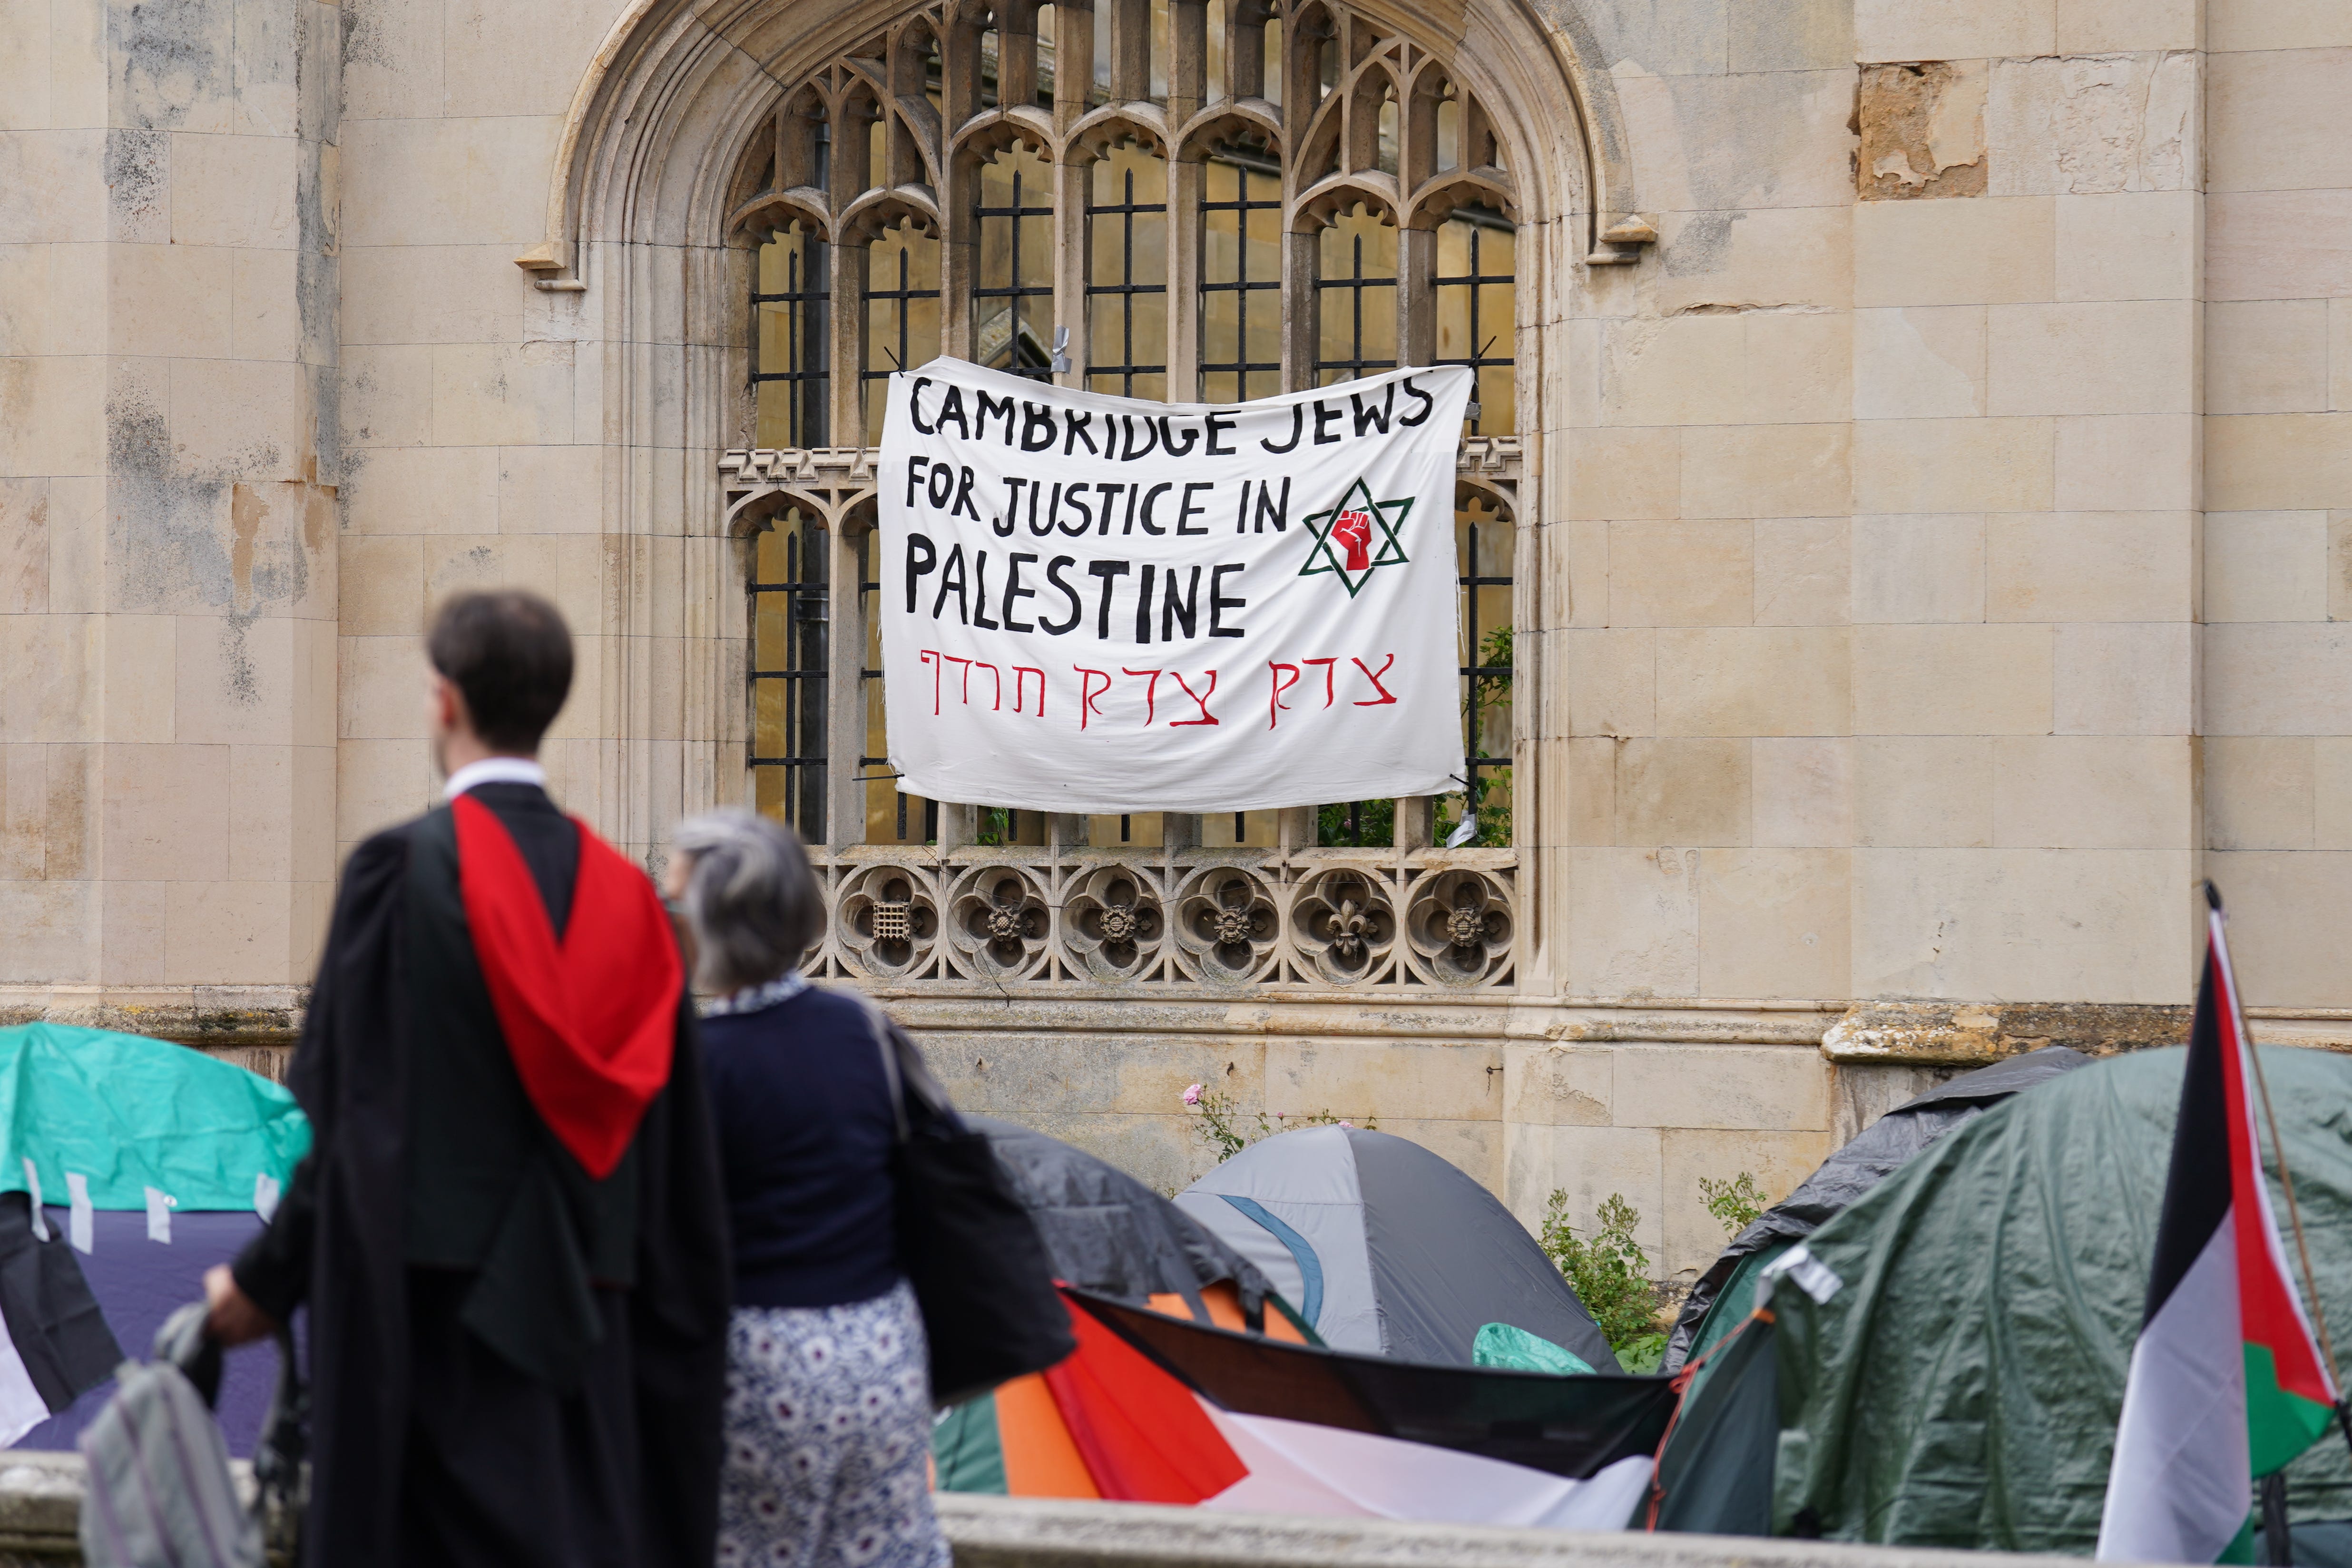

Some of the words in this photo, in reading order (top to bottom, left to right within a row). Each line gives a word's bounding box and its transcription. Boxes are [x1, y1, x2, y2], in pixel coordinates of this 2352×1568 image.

[909, 377, 1242, 461] CAMBRIDGE
[1260, 369, 1433, 454] JEWS
[906, 456, 981, 522] FOR
[993, 477, 1214, 538] JUSTICE
[1237, 477, 1291, 534] IN
[906, 533, 1246, 644] PALESTINE
[921, 649, 1045, 717] תרדף
[1073, 664, 1219, 731] צדק
[1268, 653, 1397, 730] צדק
